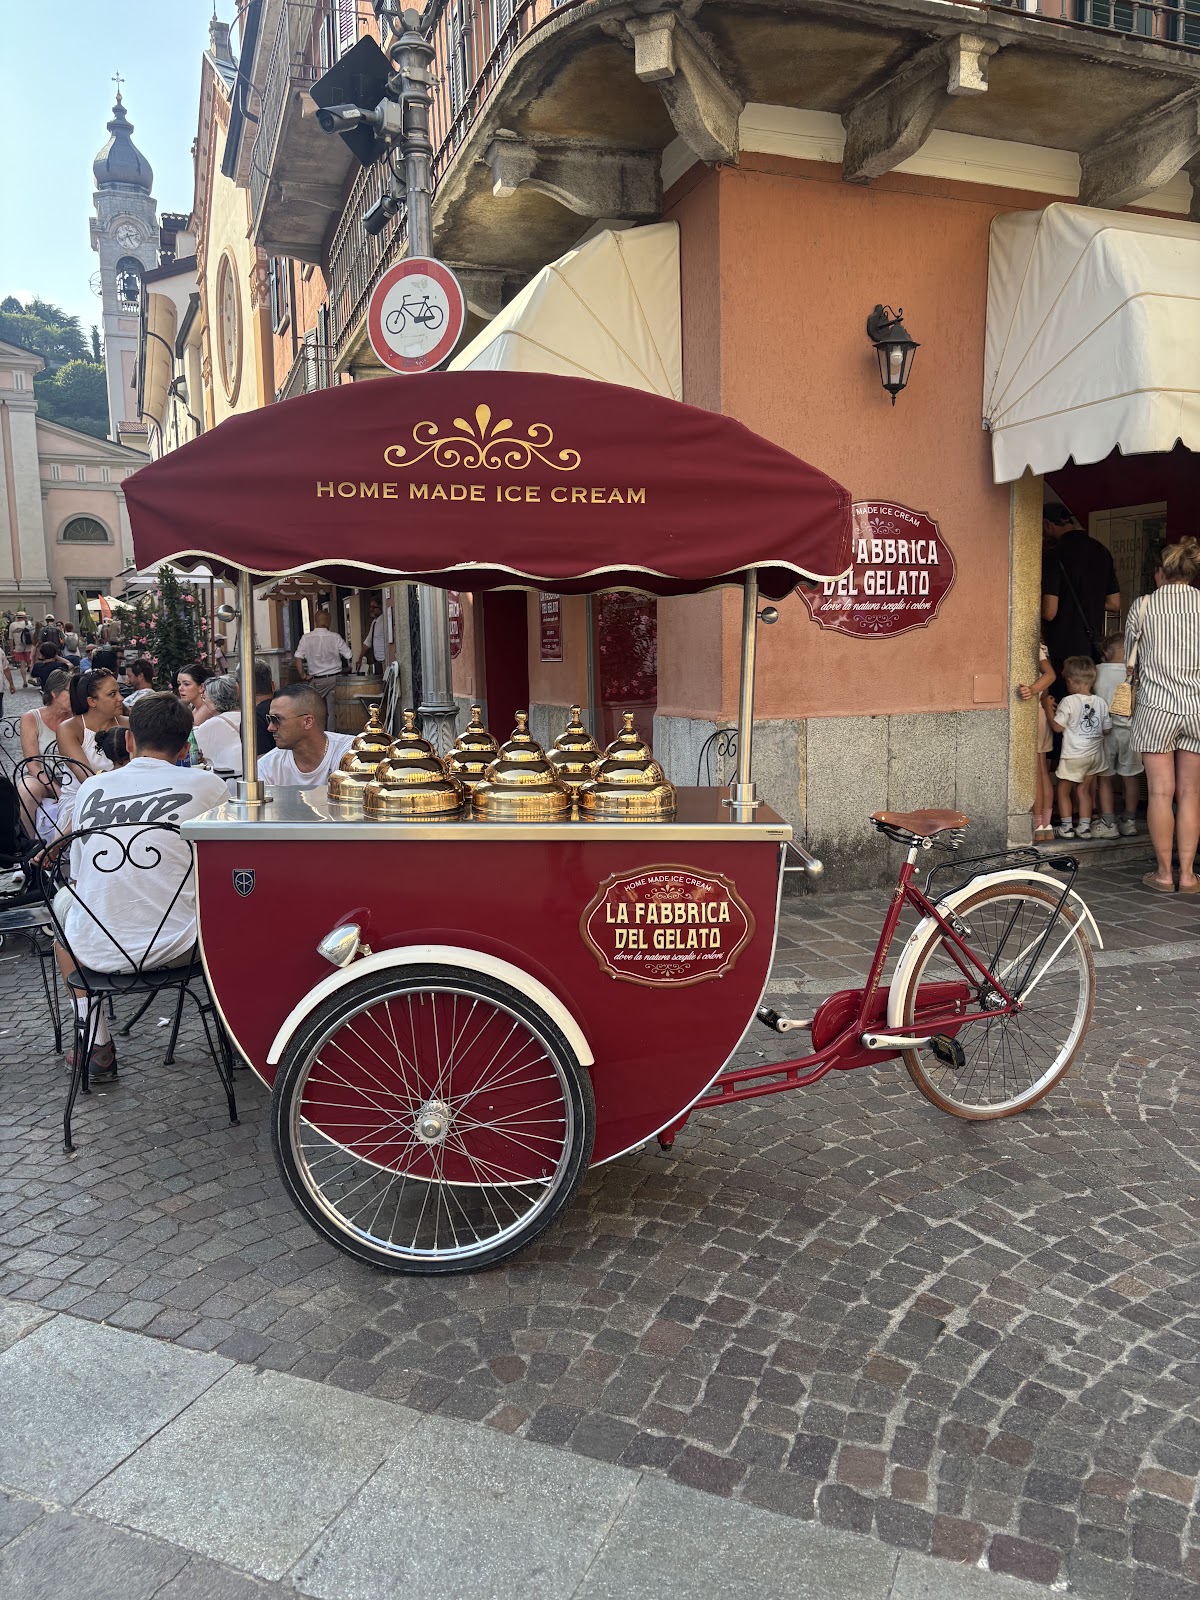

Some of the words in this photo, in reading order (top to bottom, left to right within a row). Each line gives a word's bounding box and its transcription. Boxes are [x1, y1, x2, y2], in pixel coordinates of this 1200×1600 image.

[316, 481, 398, 499] HOME
[409, 483, 486, 502] MADE
[496, 485, 541, 503] ICE
[550, 487, 647, 504] CREAM
[856, 506, 879, 515] MADE
[879, 507, 893, 515] ICE
[894, 509, 921, 528] CREAM
[852, 538, 939, 565] ABBRICA
[822, 570, 858, 596] DEL
[863, 570, 930, 596] GELATO
[820, 599, 841, 611] dove
[841, 599, 851, 611] la
[853, 600, 880, 611] natura
[881, 599, 905, 613] sceglie
[910, 598, 932, 610] colori
[624, 878, 647, 892] HOME
[647, 875, 670, 884] MADE
[671, 875, 684, 884] ICE
[685, 877, 712, 892] CREAM
[605, 902, 630, 924] LA
[635, 901, 731, 925] FABBRICA
[614, 928, 649, 949] DEL
[653, 927, 721, 949] GELATO
[613, 951, 633, 961] dove
[634, 951, 643, 961] la
[643, 952, 670, 961] natura
[671, 950, 697, 962] sceglie
[702, 950, 725, 960] colori
